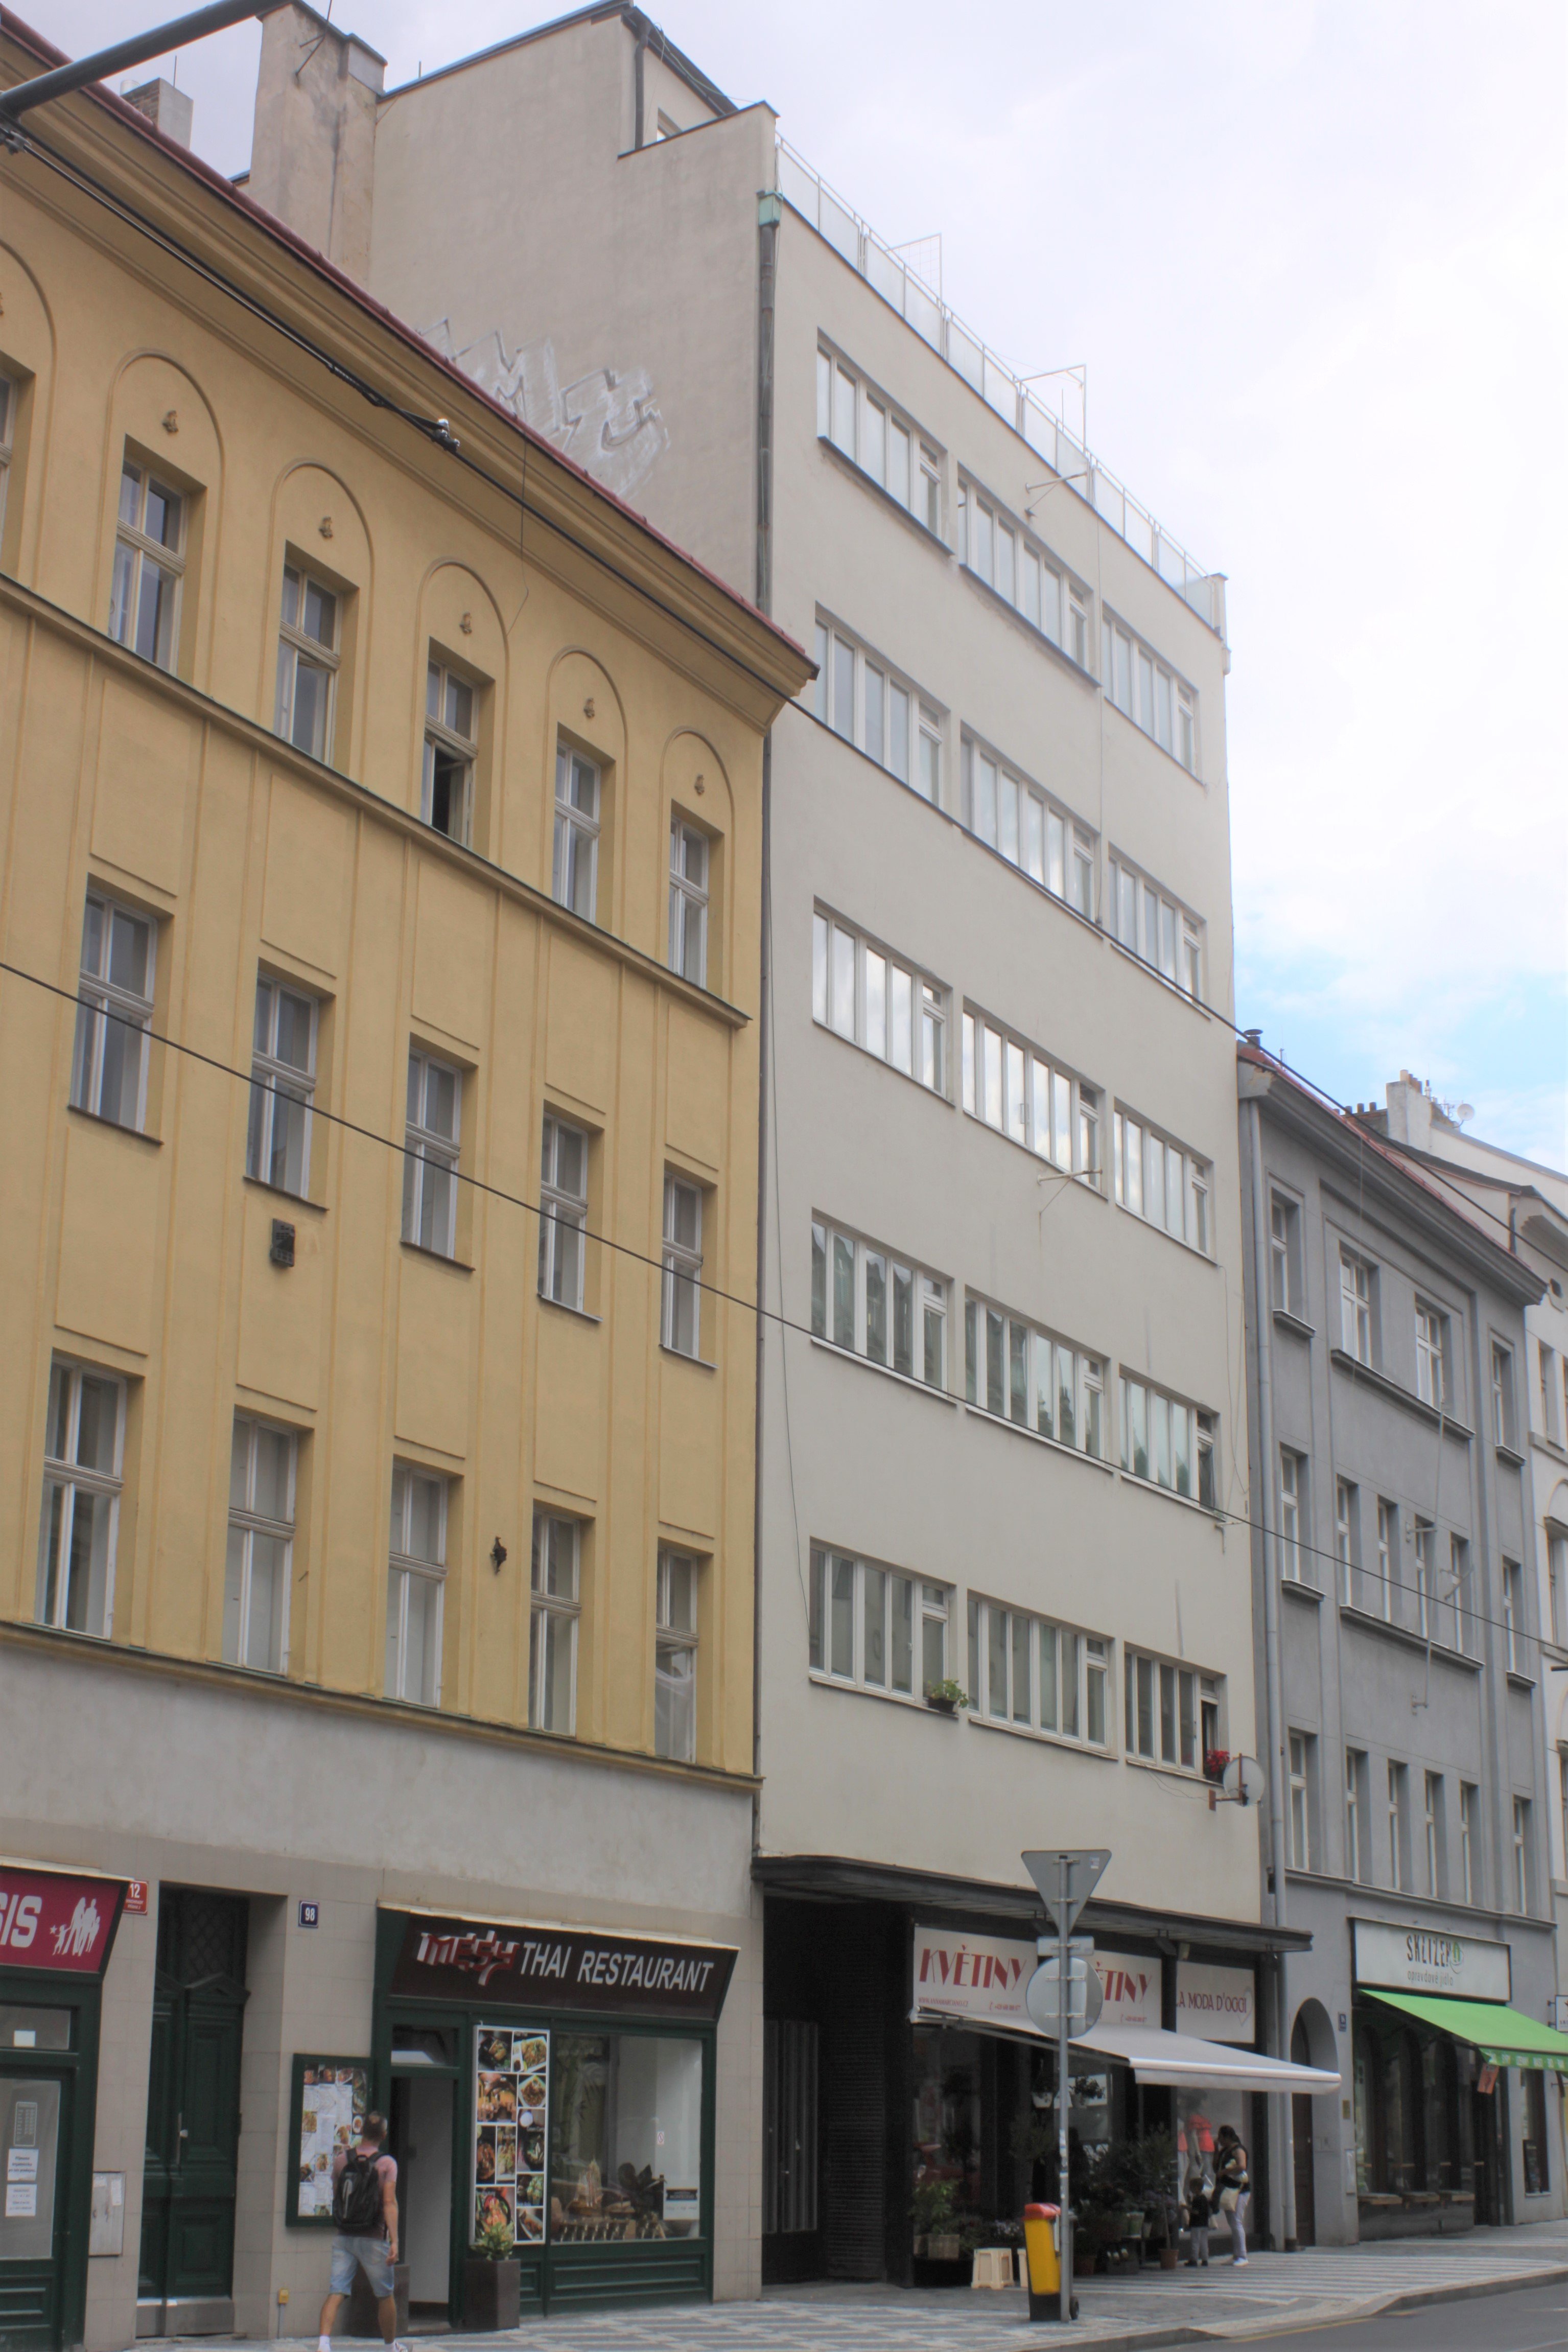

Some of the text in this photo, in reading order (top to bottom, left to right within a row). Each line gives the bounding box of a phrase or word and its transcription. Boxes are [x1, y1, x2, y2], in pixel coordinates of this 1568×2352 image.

[130, 1883, 141, 1899] 12
[0, 1892, 42, 1948] IS
[305, 1907, 315, 1921] 98
[520, 1941, 572, 1978] THAI
[577, 1950, 714, 1992] RESTAURANT
[919, 1944, 1027, 1991] KVĚTINY
[1095, 1961, 1153, 2004] TINY
[1176, 1991, 1185, 2008] A
[1187, 1992, 1214, 2011] MODA
